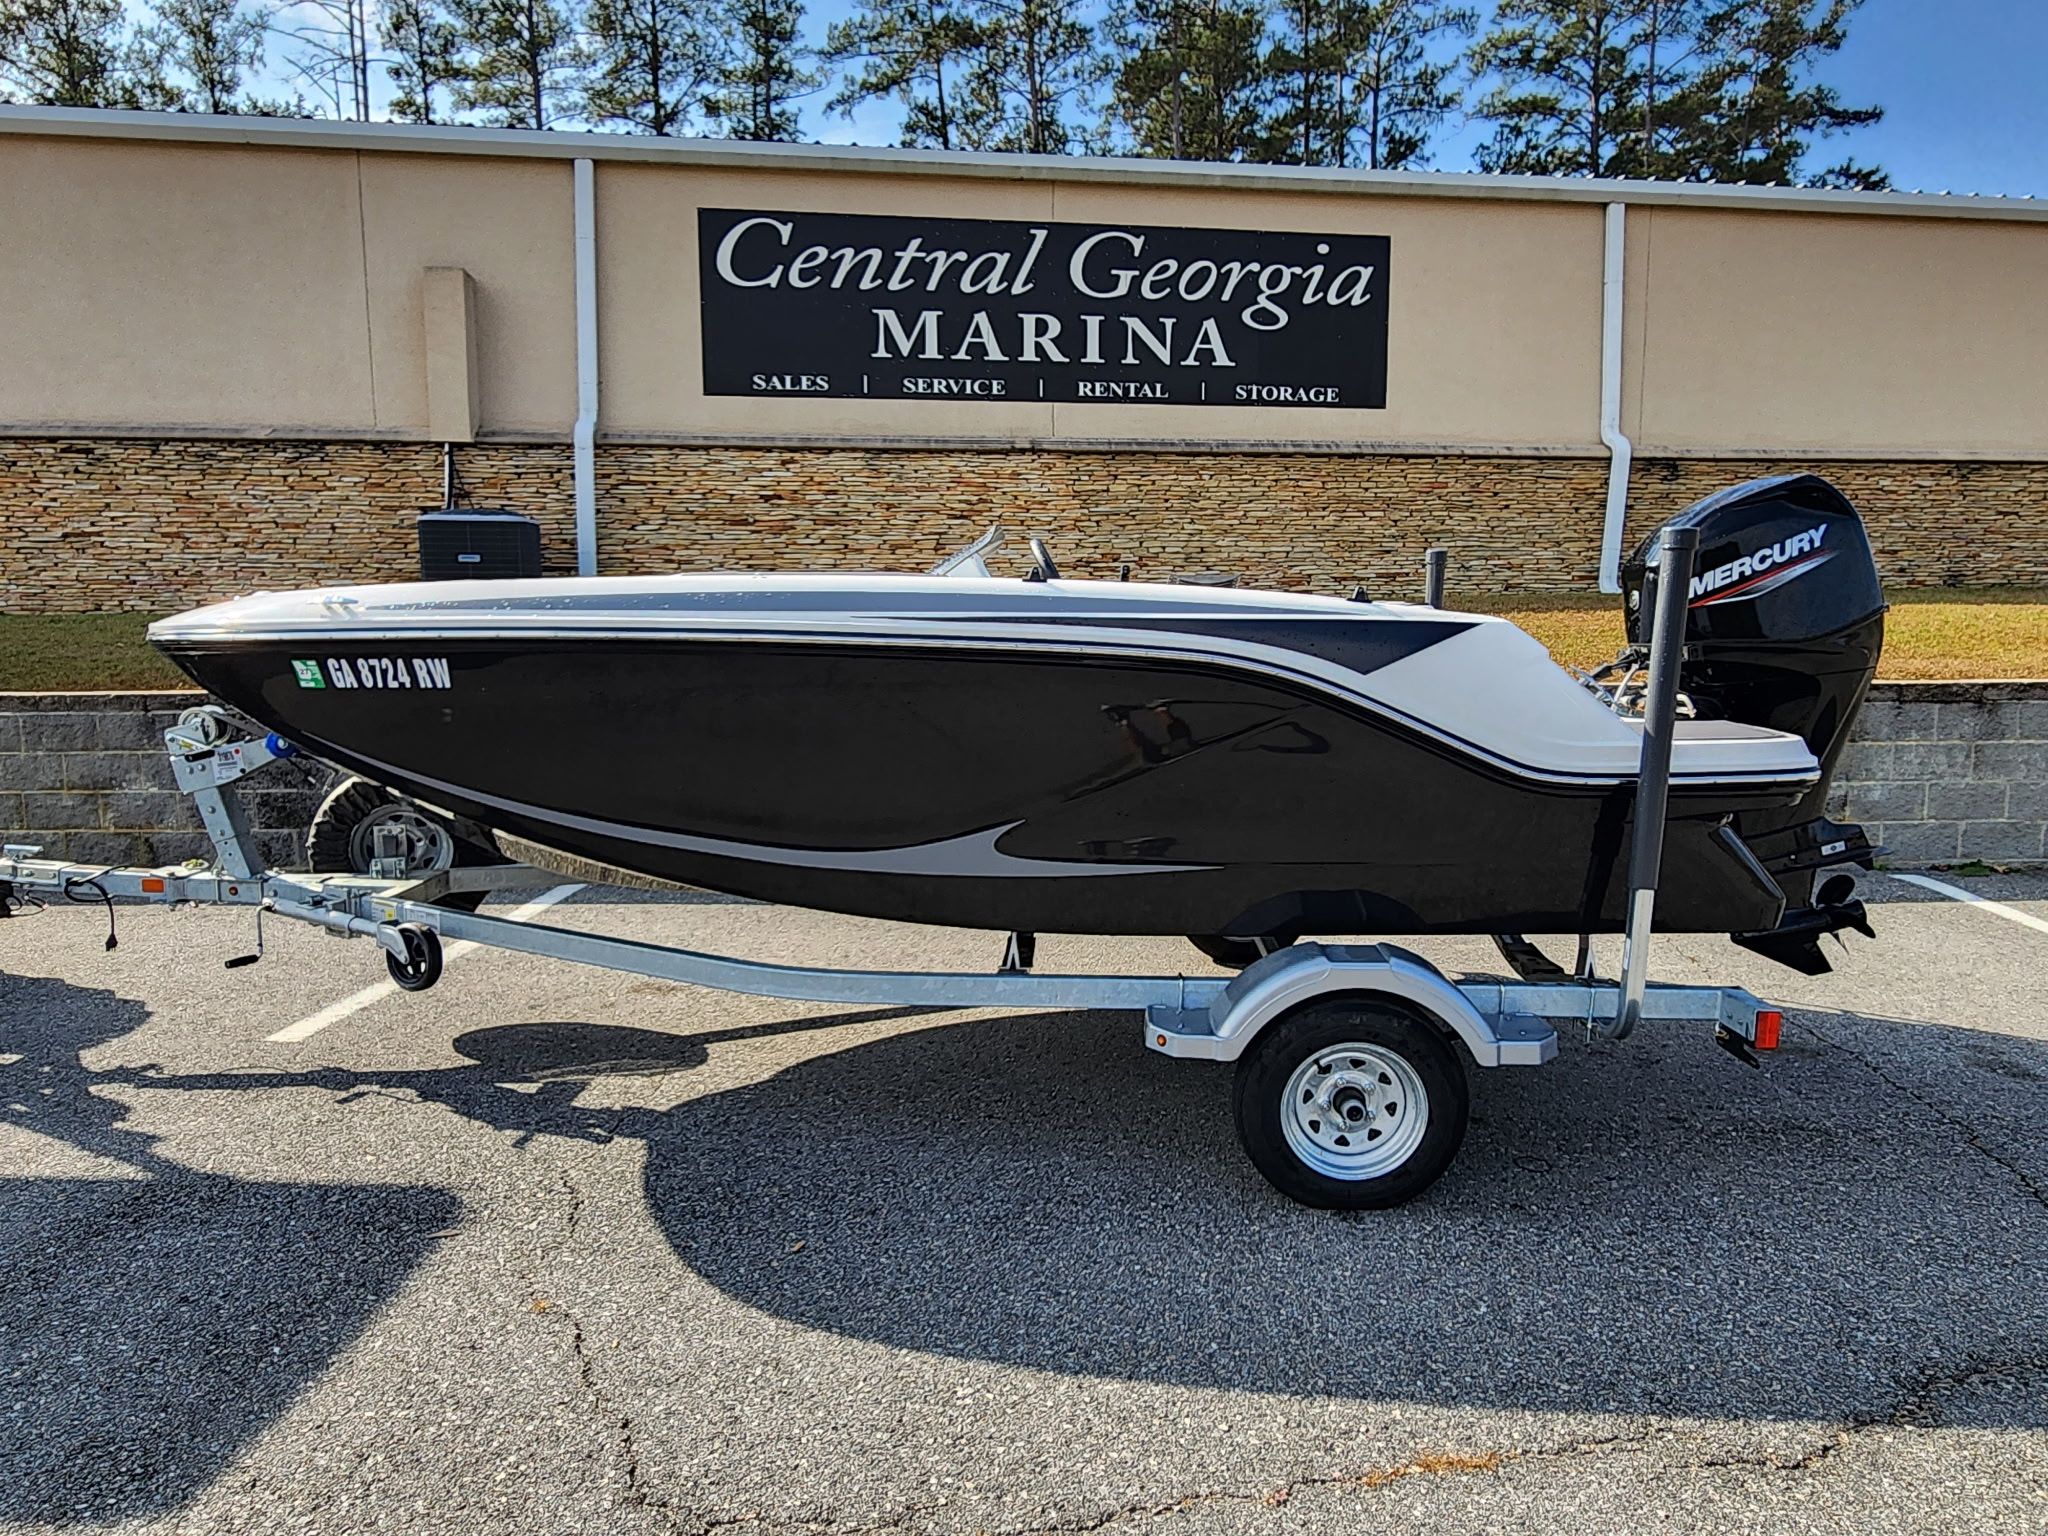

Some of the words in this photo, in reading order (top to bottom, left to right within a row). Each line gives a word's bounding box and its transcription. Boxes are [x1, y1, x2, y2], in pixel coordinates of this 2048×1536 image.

[715, 217, 1048, 295] Central
[1070, 231, 1374, 330] Georgia
[871, 309, 1236, 366] MARINA
[752, 374, 829, 391] SALES
[902, 377, 1006, 396] SERVICE
[1077, 381, 1169, 398] RENTAL
[1235, 383, 1340, 403] STORAGE
[1689, 523, 1828, 599] MERCURY
[327, 658, 358, 688] GA
[357, 658, 411, 688] 8724
[412, 658, 451, 688] RW
